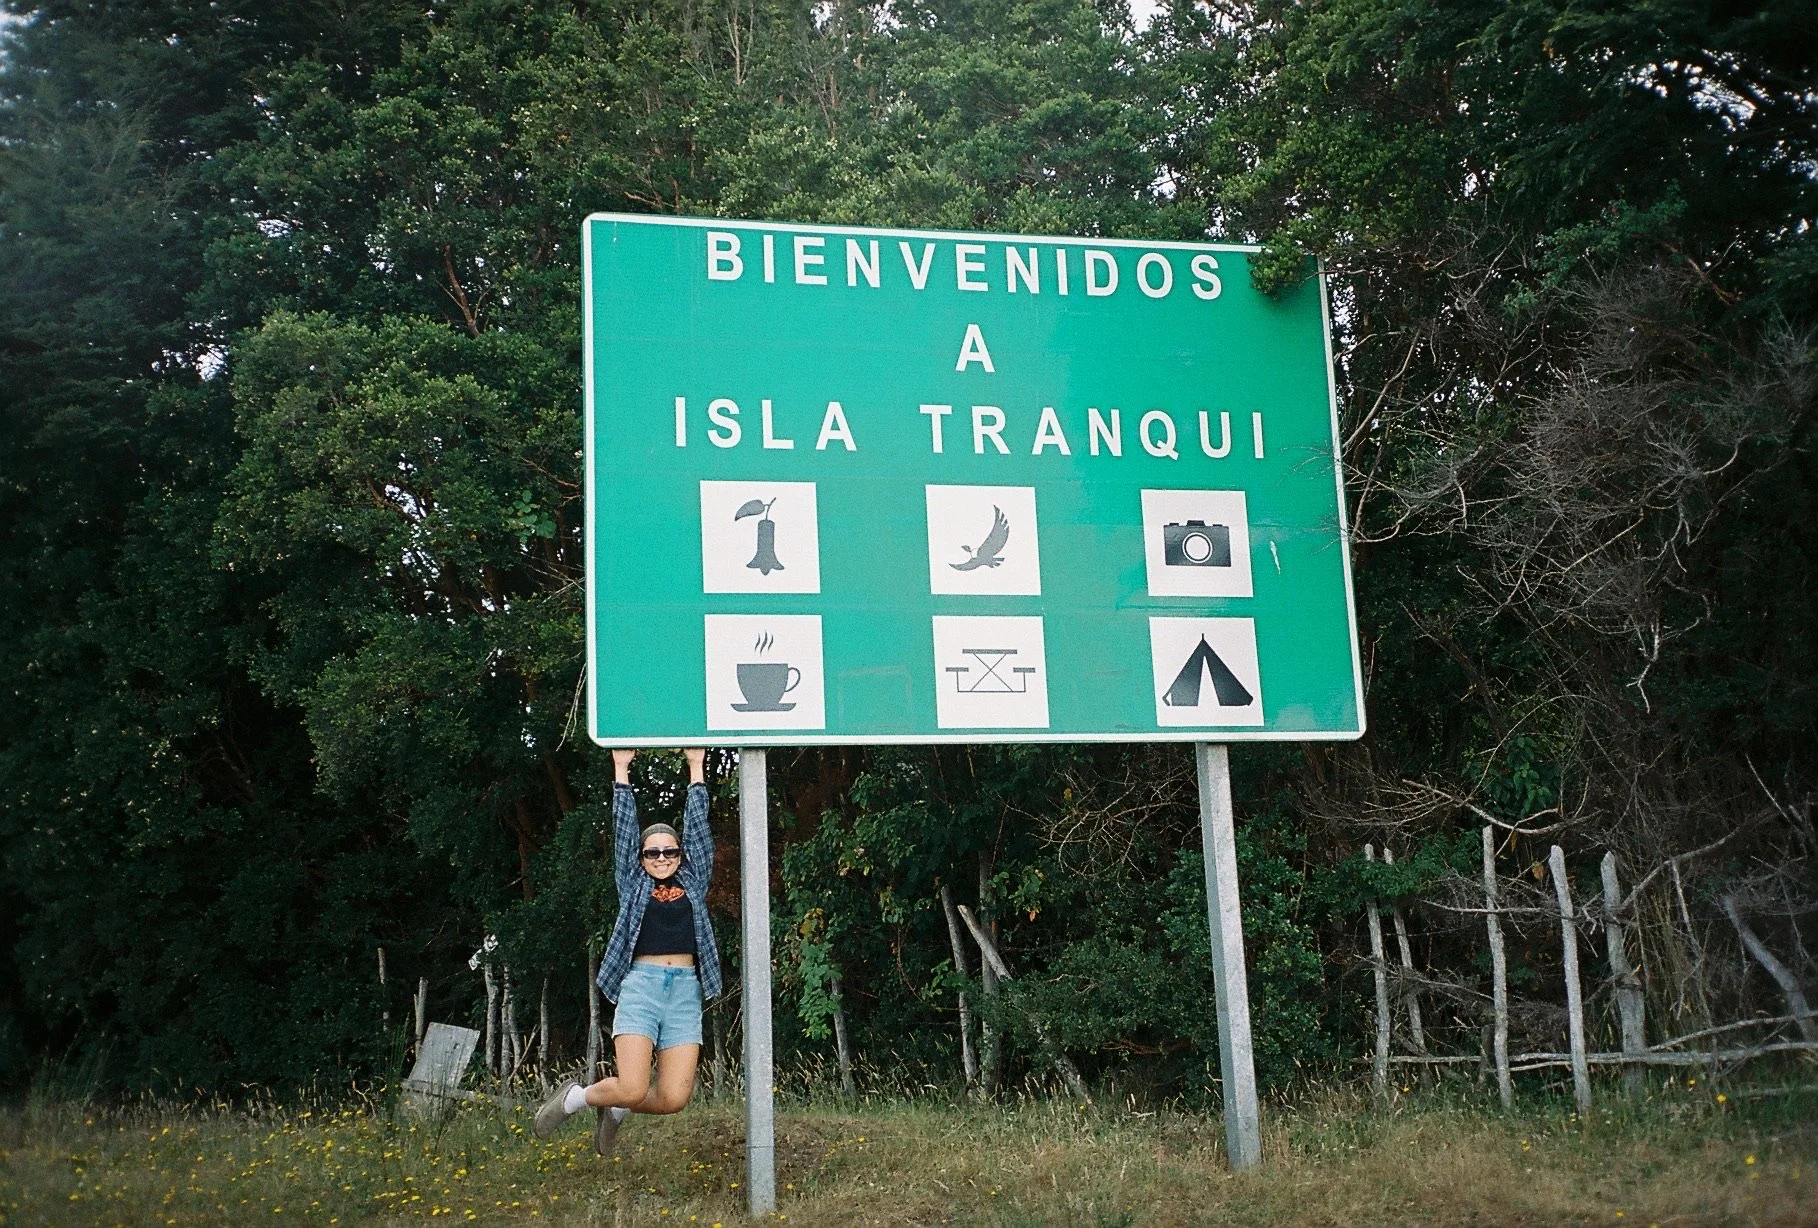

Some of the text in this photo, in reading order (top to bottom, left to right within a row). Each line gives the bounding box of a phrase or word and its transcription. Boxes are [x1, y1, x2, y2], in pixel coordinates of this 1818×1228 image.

[706, 231, 1222, 300] BIENVENIDOS
[956, 324, 995, 372] A
[675, 397, 1264, 460] ISLA TRANQUI
